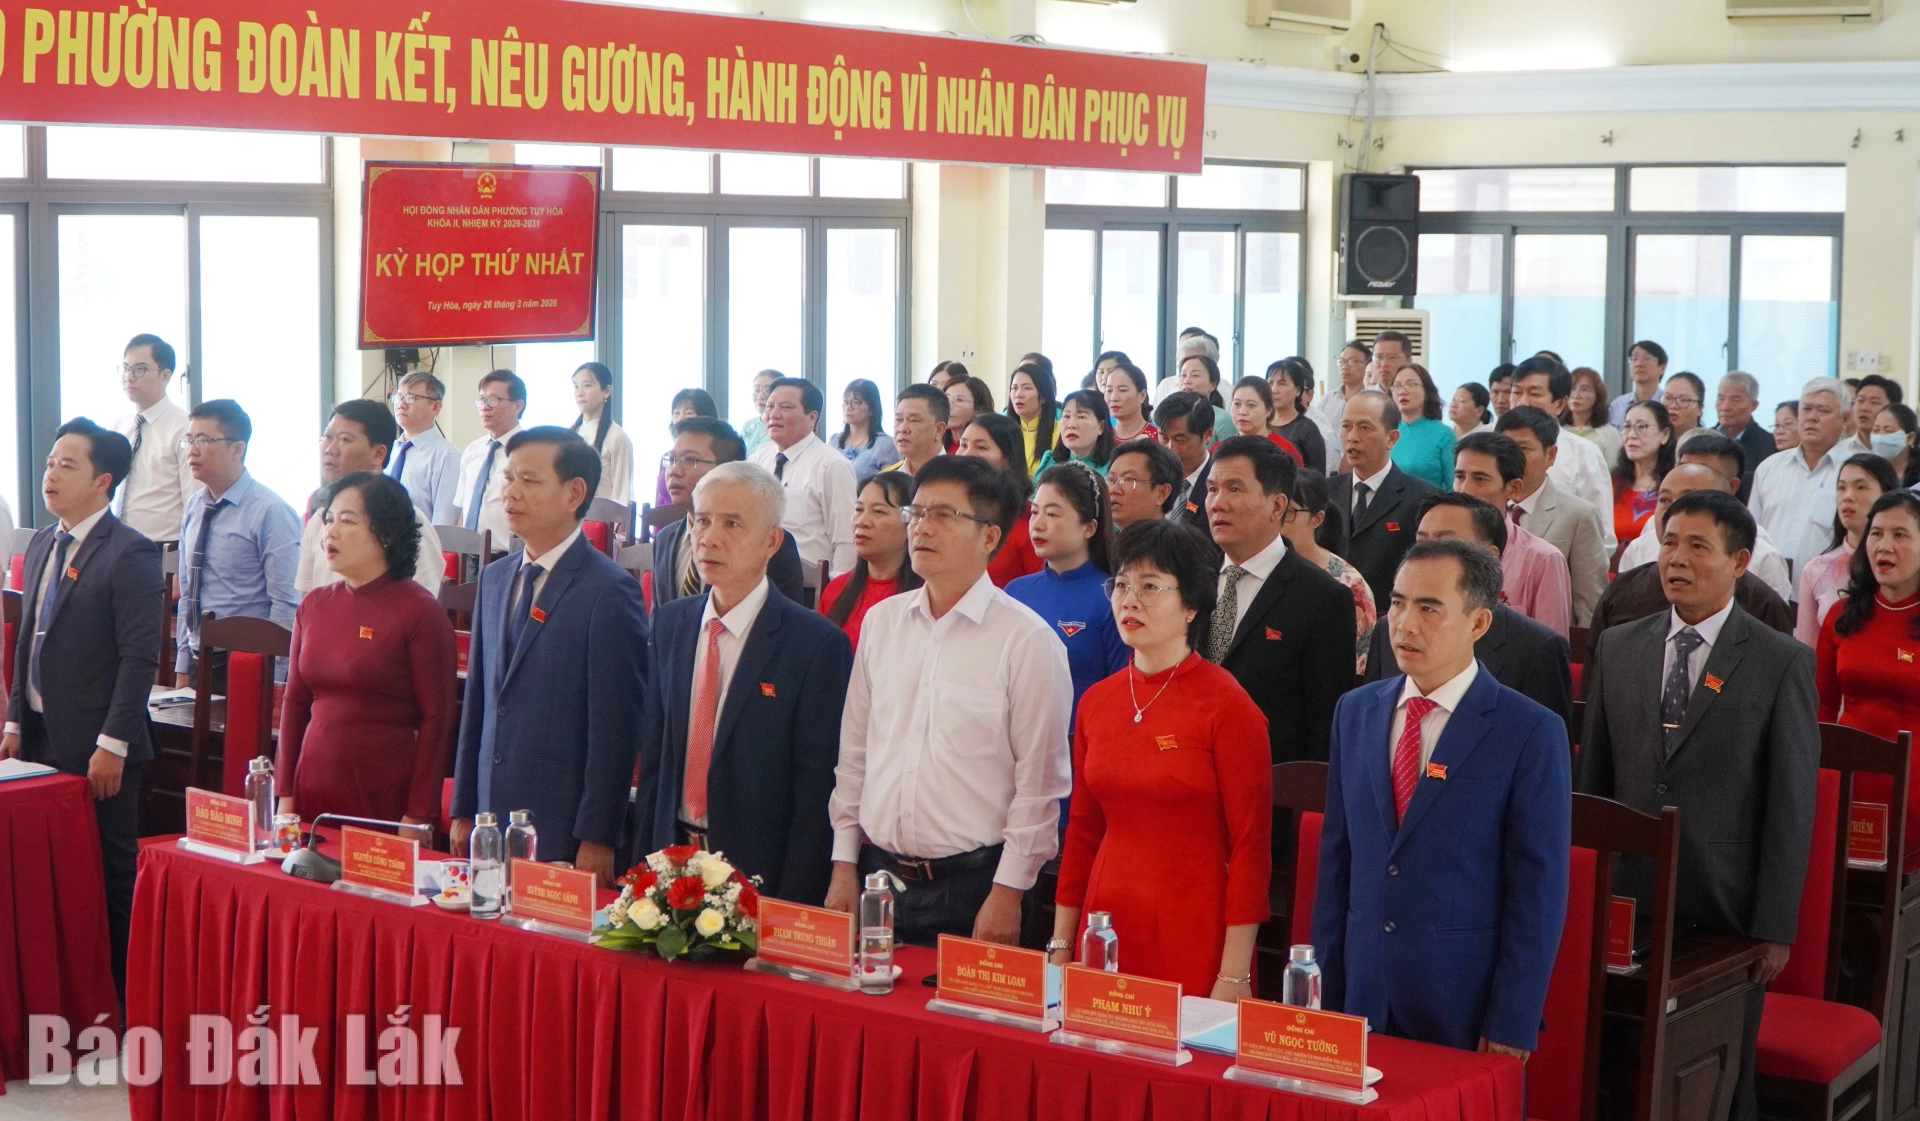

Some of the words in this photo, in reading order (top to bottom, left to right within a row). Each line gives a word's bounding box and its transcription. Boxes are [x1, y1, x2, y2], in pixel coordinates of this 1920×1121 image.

[23, 0, 221, 92] PHƯỜNG
[236, 10, 360, 99] ĐOÀN
[375, 11, 456, 113] KẾT,
[471, 26, 549, 110] NÊU
[561, 42, 695, 125] GƯƠNG,
[706, 45, 798, 124] HÀNH
[806, 54, 892, 140] ĐỘNG
[901, 61, 928, 132] VÌ
[936, 67, 1015, 138] NHÂN
[1022, 73, 1077, 141] DÂN
[1083, 89, 1150, 156] PHỤC
[1157, 95, 1188, 160] VỤ
[403, 205, 418, 216] HỘI
[420, 204, 445, 215] ĐỒNG
[447, 204, 470, 215] NHÂN
[472, 205, 490, 216] DÂN
[491, 205, 528, 216] PHƯỜNG
[530, 206, 545, 216] TUY
[546, 205, 564, 216] HÒA
[462, 218, 488, 230] NHIỆM
[490, 217, 502, 228] KỲ
[503, 219, 540, 229] 2026-2031
[375, 247, 409, 277] KỲ
[415, 252, 465, 282] HỌP
[471, 247, 520, 276] THỨ
[525, 247, 585, 276] NHẤT
[427, 301, 442, 312] Tuy
[443, 300, 461, 311] Hòa,
[462, 300, 482, 312] ngày
[483, 300, 493, 309] 26
[493, 299, 516, 311] tháng
[516, 299, 522, 309] 3
[522, 299, 539, 308] năm
[540, 298, 558, 308] 2026
[224, 813, 243, 828] MINH
[773, 926, 792, 940] PHẠM
[792, 930, 814, 944] TRUNG
[977, 969, 990, 983] THỊ
[991, 972, 1006, 984] KIM
[1007, 974, 1026, 988] LOAN
[1092, 997, 1120, 1013] PHẠM
[1121, 1003, 1143, 1017] NHƯ
[1263, 1030, 1277, 1044] VŨ
[1278, 1034, 1305, 1050] NGỌC
[1306, 1038, 1339, 1055] TƯỜNG
